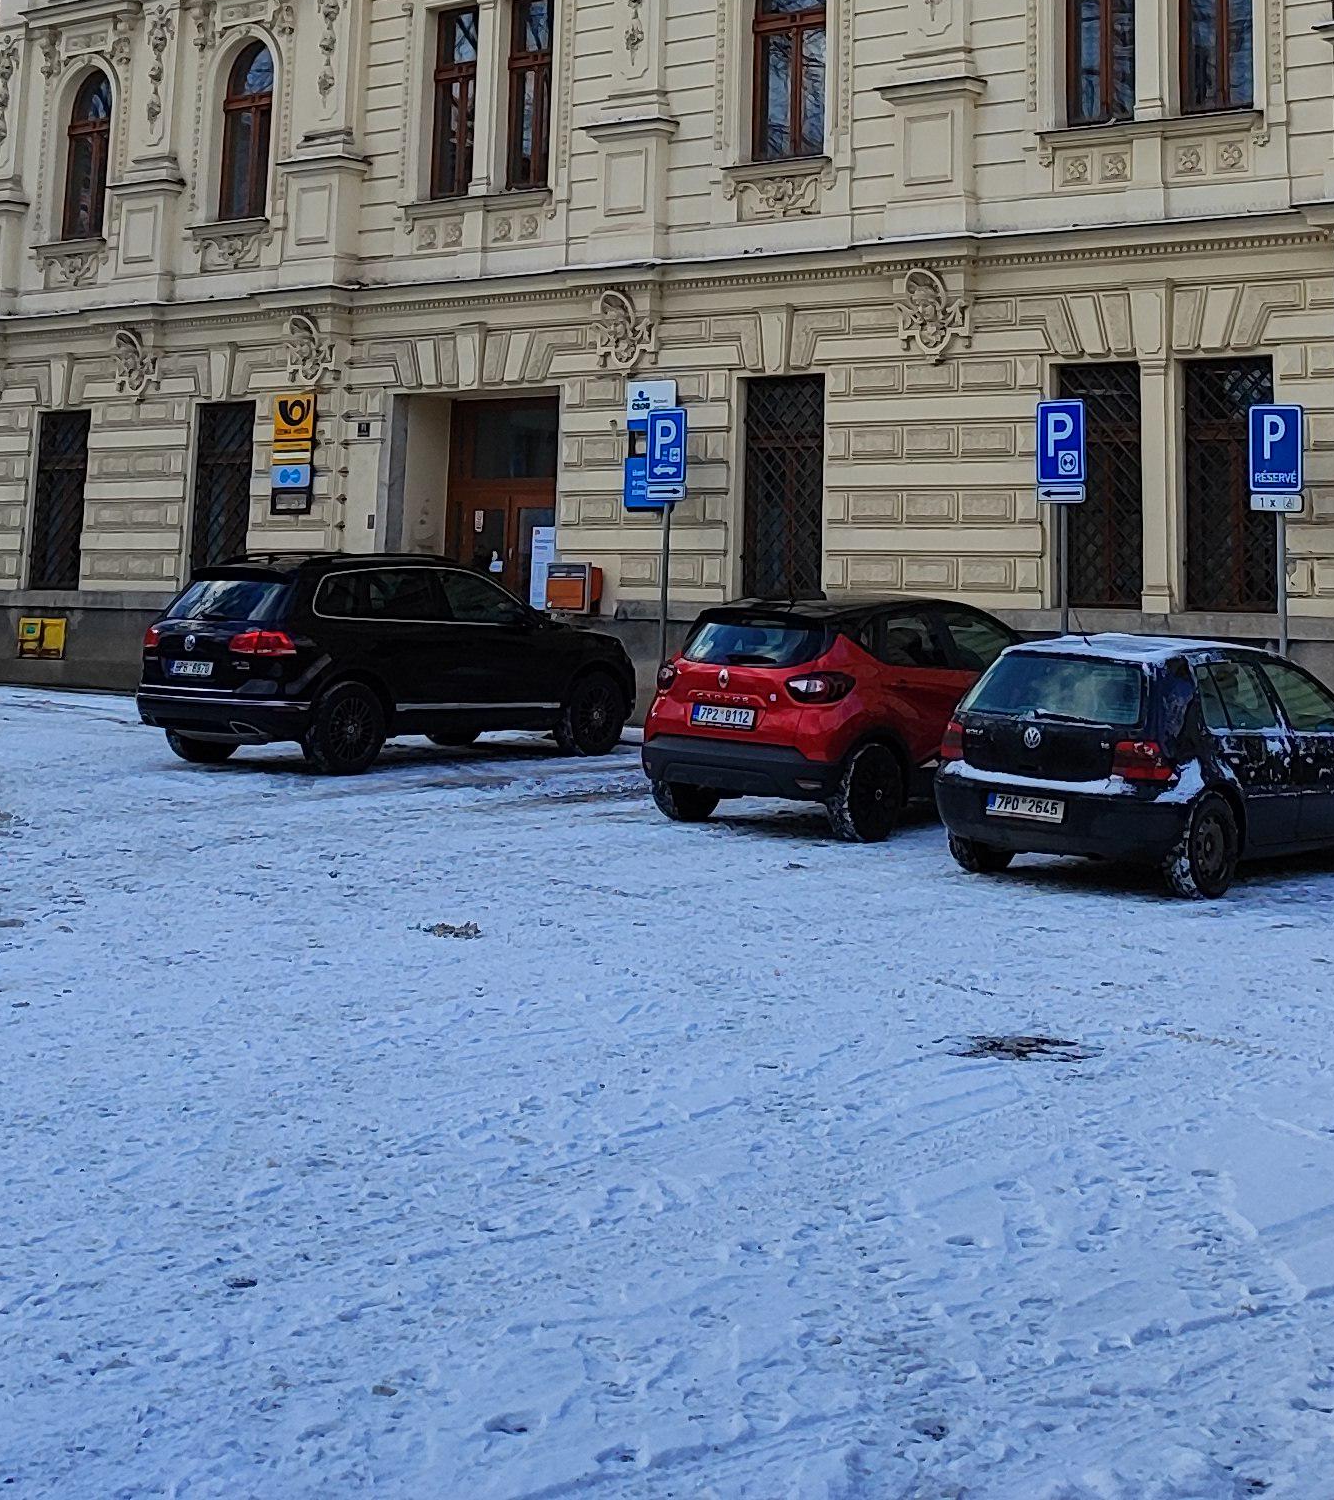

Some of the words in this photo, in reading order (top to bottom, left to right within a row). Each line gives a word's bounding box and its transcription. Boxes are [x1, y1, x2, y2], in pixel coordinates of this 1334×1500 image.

[655, 419, 677, 460] P
[1047, 412, 1074, 458] P
[1263, 414, 1286, 460] P
[1254, 470, 1297, 483] RÉSERVÉ
[700, 707, 719, 721] 7P2
[1027, 800, 1059, 816] 2645
